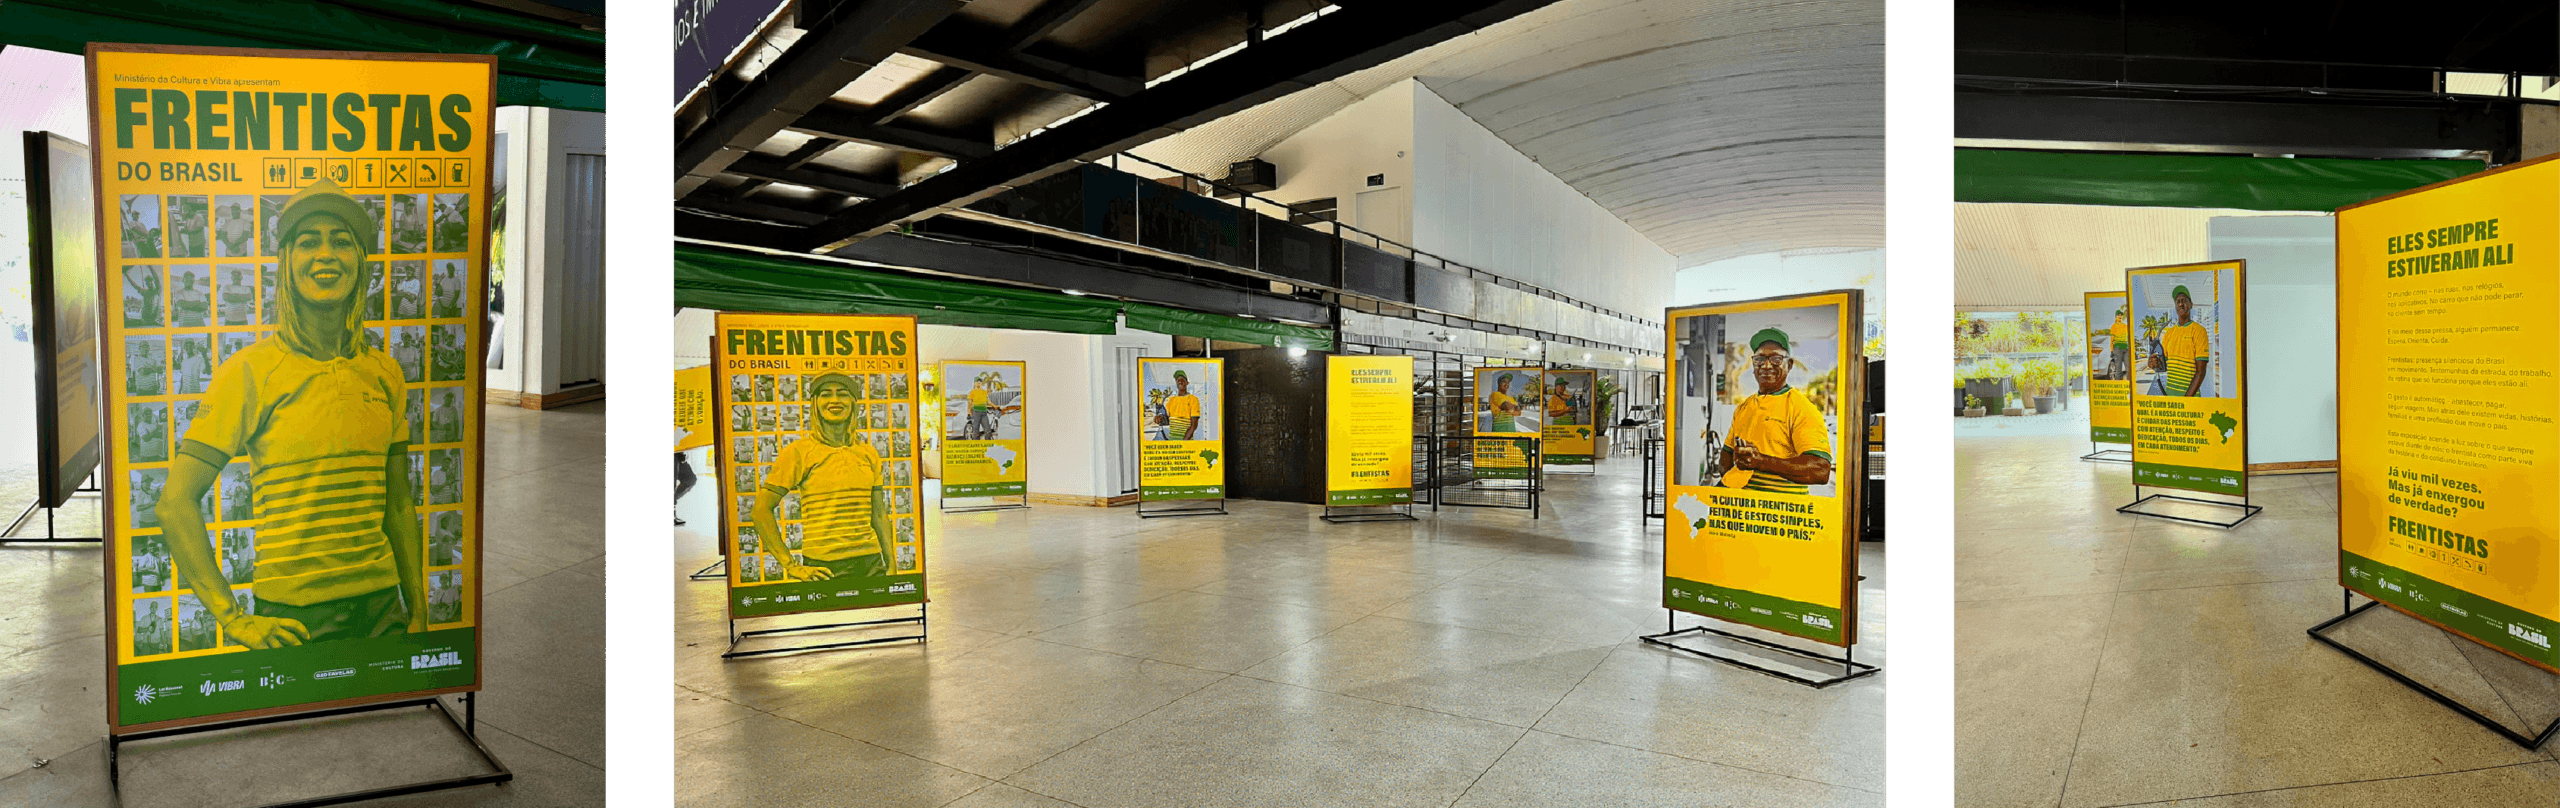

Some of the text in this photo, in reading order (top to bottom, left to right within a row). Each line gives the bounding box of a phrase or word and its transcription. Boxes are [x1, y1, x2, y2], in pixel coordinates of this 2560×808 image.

[114, 73, 156, 83] Ministério
[170, 76, 201, 84] Cultura
[210, 76, 231, 86] Vibra
[234, 79, 281, 87] apresentam
[114, 88, 472, 152] FRENTISTAS
[118, 161, 242, 182] DO BRASIL
[2388, 218, 2498, 255] ELES SEMPRE
[2388, 243, 2513, 278] ESTIVERAM ALI
[2476, 282, 2504, 290] relógios,
[2398, 298, 2428, 308] aplicativos.
[2485, 293, 2502, 301] pode
[2504, 292, 2523, 300] parar,
[727, 329, 906, 355] FRENTISTAS
[729, 360, 791, 369] DO BRASIL
[2520, 369, 2553, 377] trabalho,
[2459, 378, 2481, 386] porque
[2498, 379, 2517, 387] estão
[2452, 398, 2484, 407] abastecer,
[2427, 416, 2453, 424] profissão
[2472, 410, 2496, 418] existem
[2498, 412, 2518, 421] vidas,
[2520, 414, 2554, 424] histórias,
[2138, 434, 2168, 442] DEDICAÇÃO,
[2150, 426, 2174, 435] ATENÇÃO,
[2175, 428, 2200, 436] RESPEITO
[2400, 432, 2427, 441] exposição
[2429, 434, 2450, 444] acende
[2467, 440, 2484, 448] sobre
[2508, 445, 2534, 455] sempre
[2398, 449, 2488, 469] história cotidiano brasileiro.
[2406, 441, 2422, 449] diante
[2451, 447, 2476, 457] frentista
[2478, 452, 2496, 460] como
[2498, 455, 2516, 464] parte
[2518, 457, 2533, 466] viva
[2388, 466, 2482, 494] Já viu mil vezes.
[2388, 479, 2485, 510] Mas já enxergou
[1720, 496, 1755, 508] CULTURA
[1758, 500, 1806, 513] FRENTISTA
[1808, 502, 1814, 514] É
[2388, 493, 2458, 518] de verdade?
[1709, 519, 1726, 529] MAS
[1728, 521, 1744, 531] QUE
[1746, 524, 1778, 536] MOVEM
[1780, 528, 1785, 536] O
[1710, 507, 1823, 530] FEITA DE GESTOS SIMPLES,
[2389, 515, 2488, 558] FRENTISTAS
[2508, 623, 2551, 648] BRASIL
[411, 652, 462, 669] BRASIL
[219, 680, 244, 691] VIBRA
